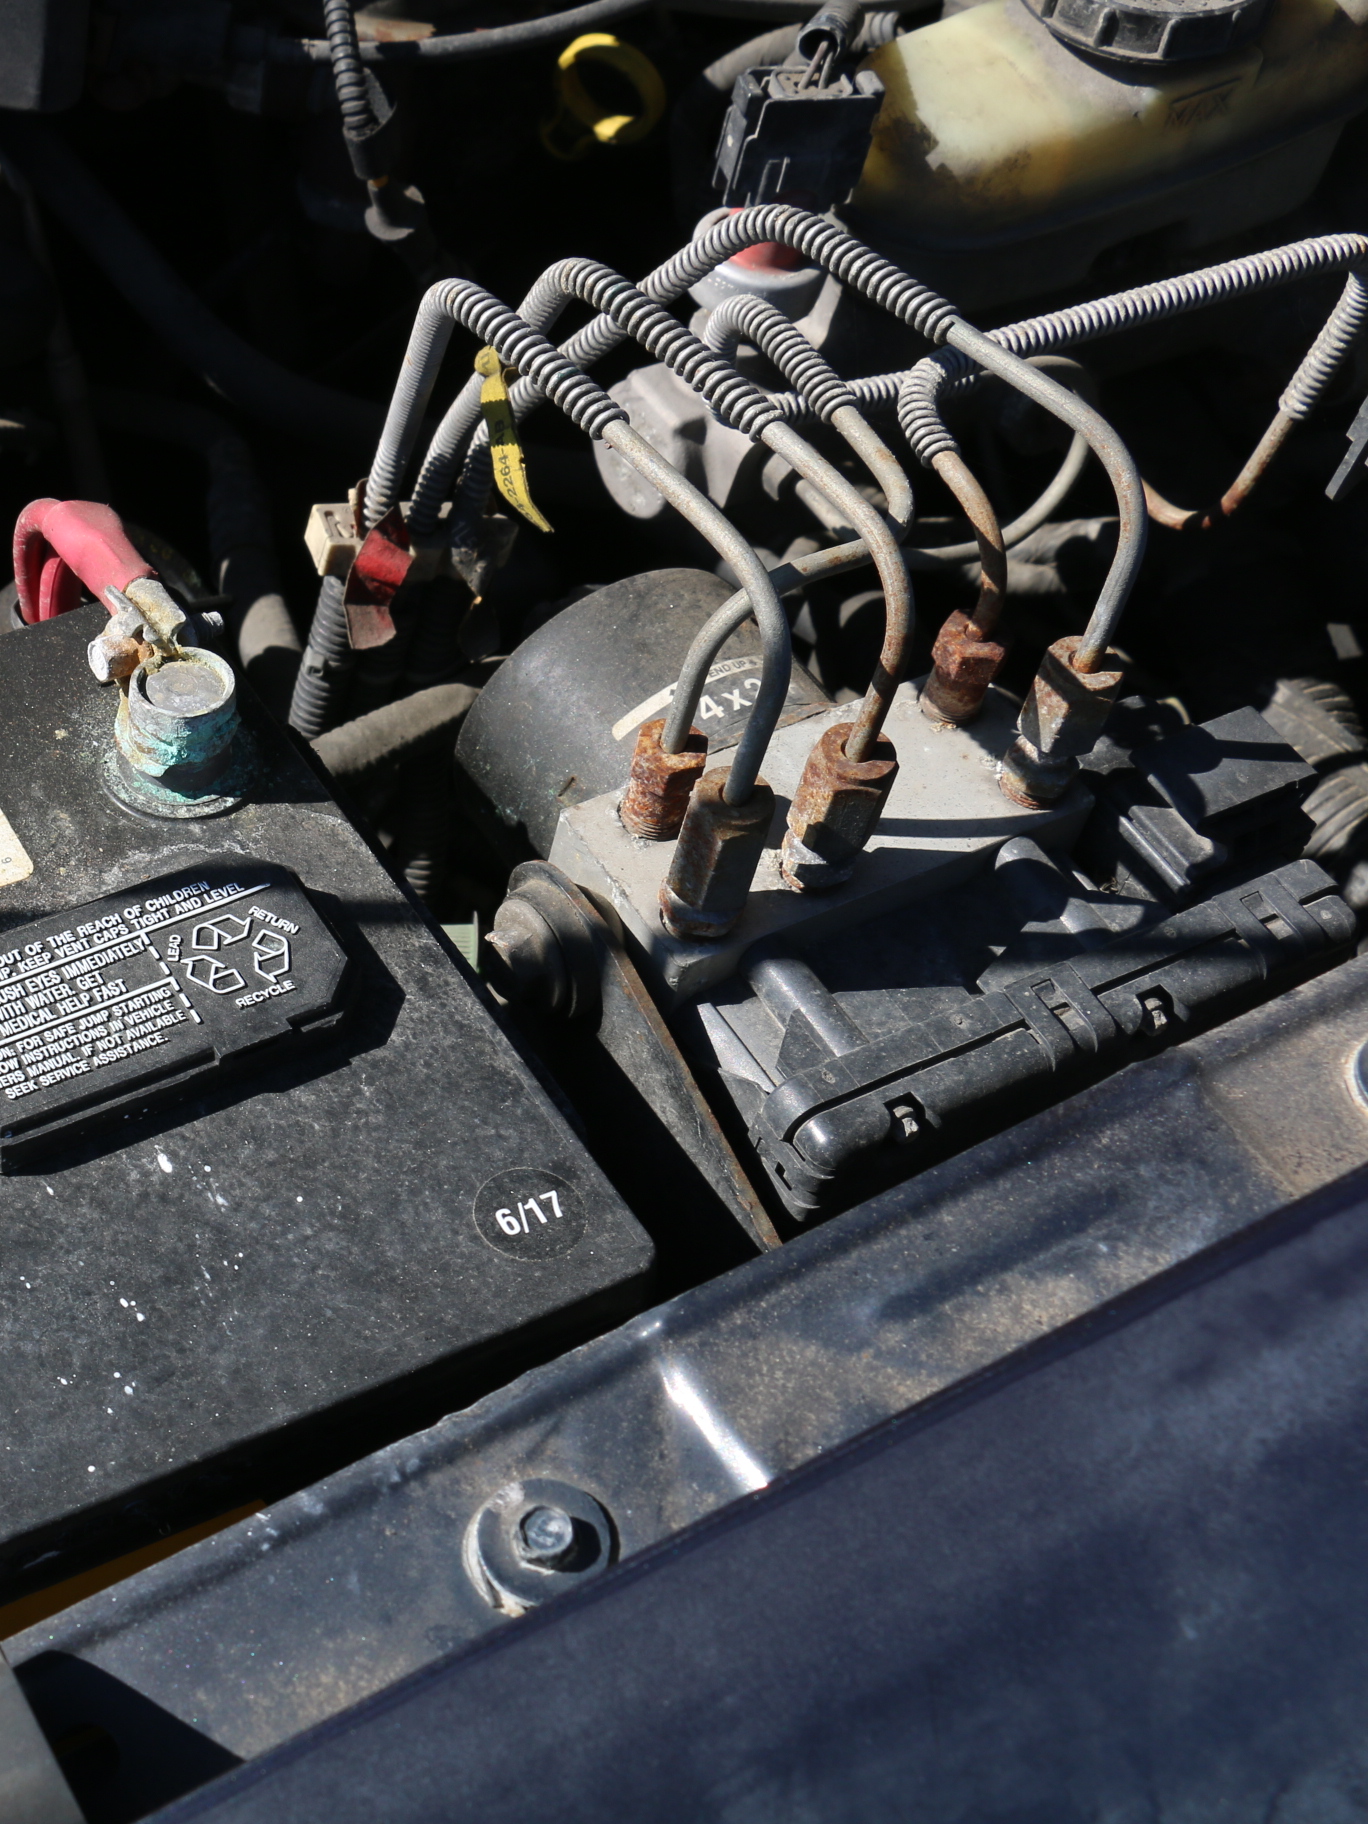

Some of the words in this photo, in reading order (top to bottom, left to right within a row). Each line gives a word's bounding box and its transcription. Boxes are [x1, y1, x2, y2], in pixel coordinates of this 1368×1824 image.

[17, 952, 52, 974] KEEP
[54, 937, 90, 960] VENT
[93, 922, 130, 945] CAPS
[131, 909, 171, 931] TIGHT
[173, 896, 202, 915] AND
[205, 881, 246, 904] LEVEL
[24, 940, 44, 956] OF
[46, 931, 76, 948] THE
[79, 910, 122, 936] REACH
[124, 904, 143, 920] OF
[144, 880, 210, 912] CHILDREN
[248, 905, 300, 935] RETURN
[25, 969, 62, 993] EYES
[61, 936, 147, 979] IMMEDIATELY
[167, 934, 181, 962] LEAD
[25, 983, 76, 1011] WATER.
[76, 970, 105, 991] GET
[56, 992, 92, 1016] HELP
[94, 978, 129, 1003] FAST
[235, 979, 296, 1008] RECYCLE
[16, 1035, 43, 1053] FOR
[43, 1022, 77, 1040] SAFE
[78, 1009, 110, 1031] JUMP
[114, 986, 172, 1014] STARTING
[20, 1024, 108, 1066] INSTRUCTIONS
[111, 1016, 124, 1029] IN
[124, 1000, 175, 1026] VEHICLE
[26, 1052, 81, 1079] MANUAL.
[81, 1044, 94, 1057] IF
[97, 1030, 124, 1050] NOT
[126, 1010, 188, 1040] AVAILABLE
[5, 1080, 39, 1100] SEEK
[39, 1059, 92, 1087] SERVICE
[93, 1031, 170, 1067] ASSISTANCE.
[494, 1189, 563, 1236] 6/17
